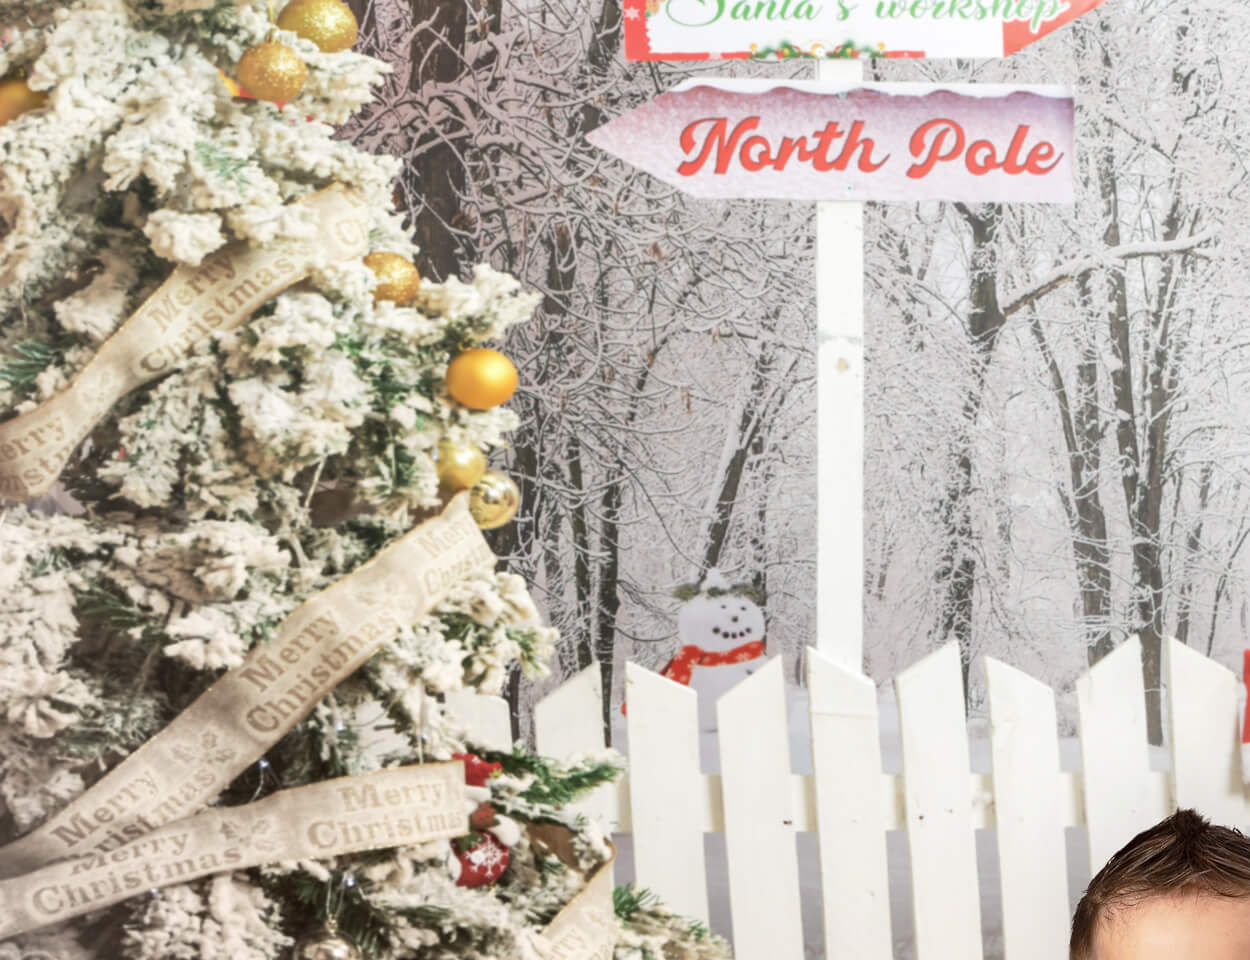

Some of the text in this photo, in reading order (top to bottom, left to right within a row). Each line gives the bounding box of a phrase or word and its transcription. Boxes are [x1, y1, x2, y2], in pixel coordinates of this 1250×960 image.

[677, 116, 1064, 180] North Pole
[147, 253, 237, 333] Merry
[0, 416, 64, 460] erry
[412, 515, 478, 559] Merr
[239, 612, 340, 693] Merry
[246, 611, 396, 733] Christmas
[50, 770, 160, 848] Merry
[336, 782, 442, 813] Merry
[32, 848, 242, 915] Christmas
